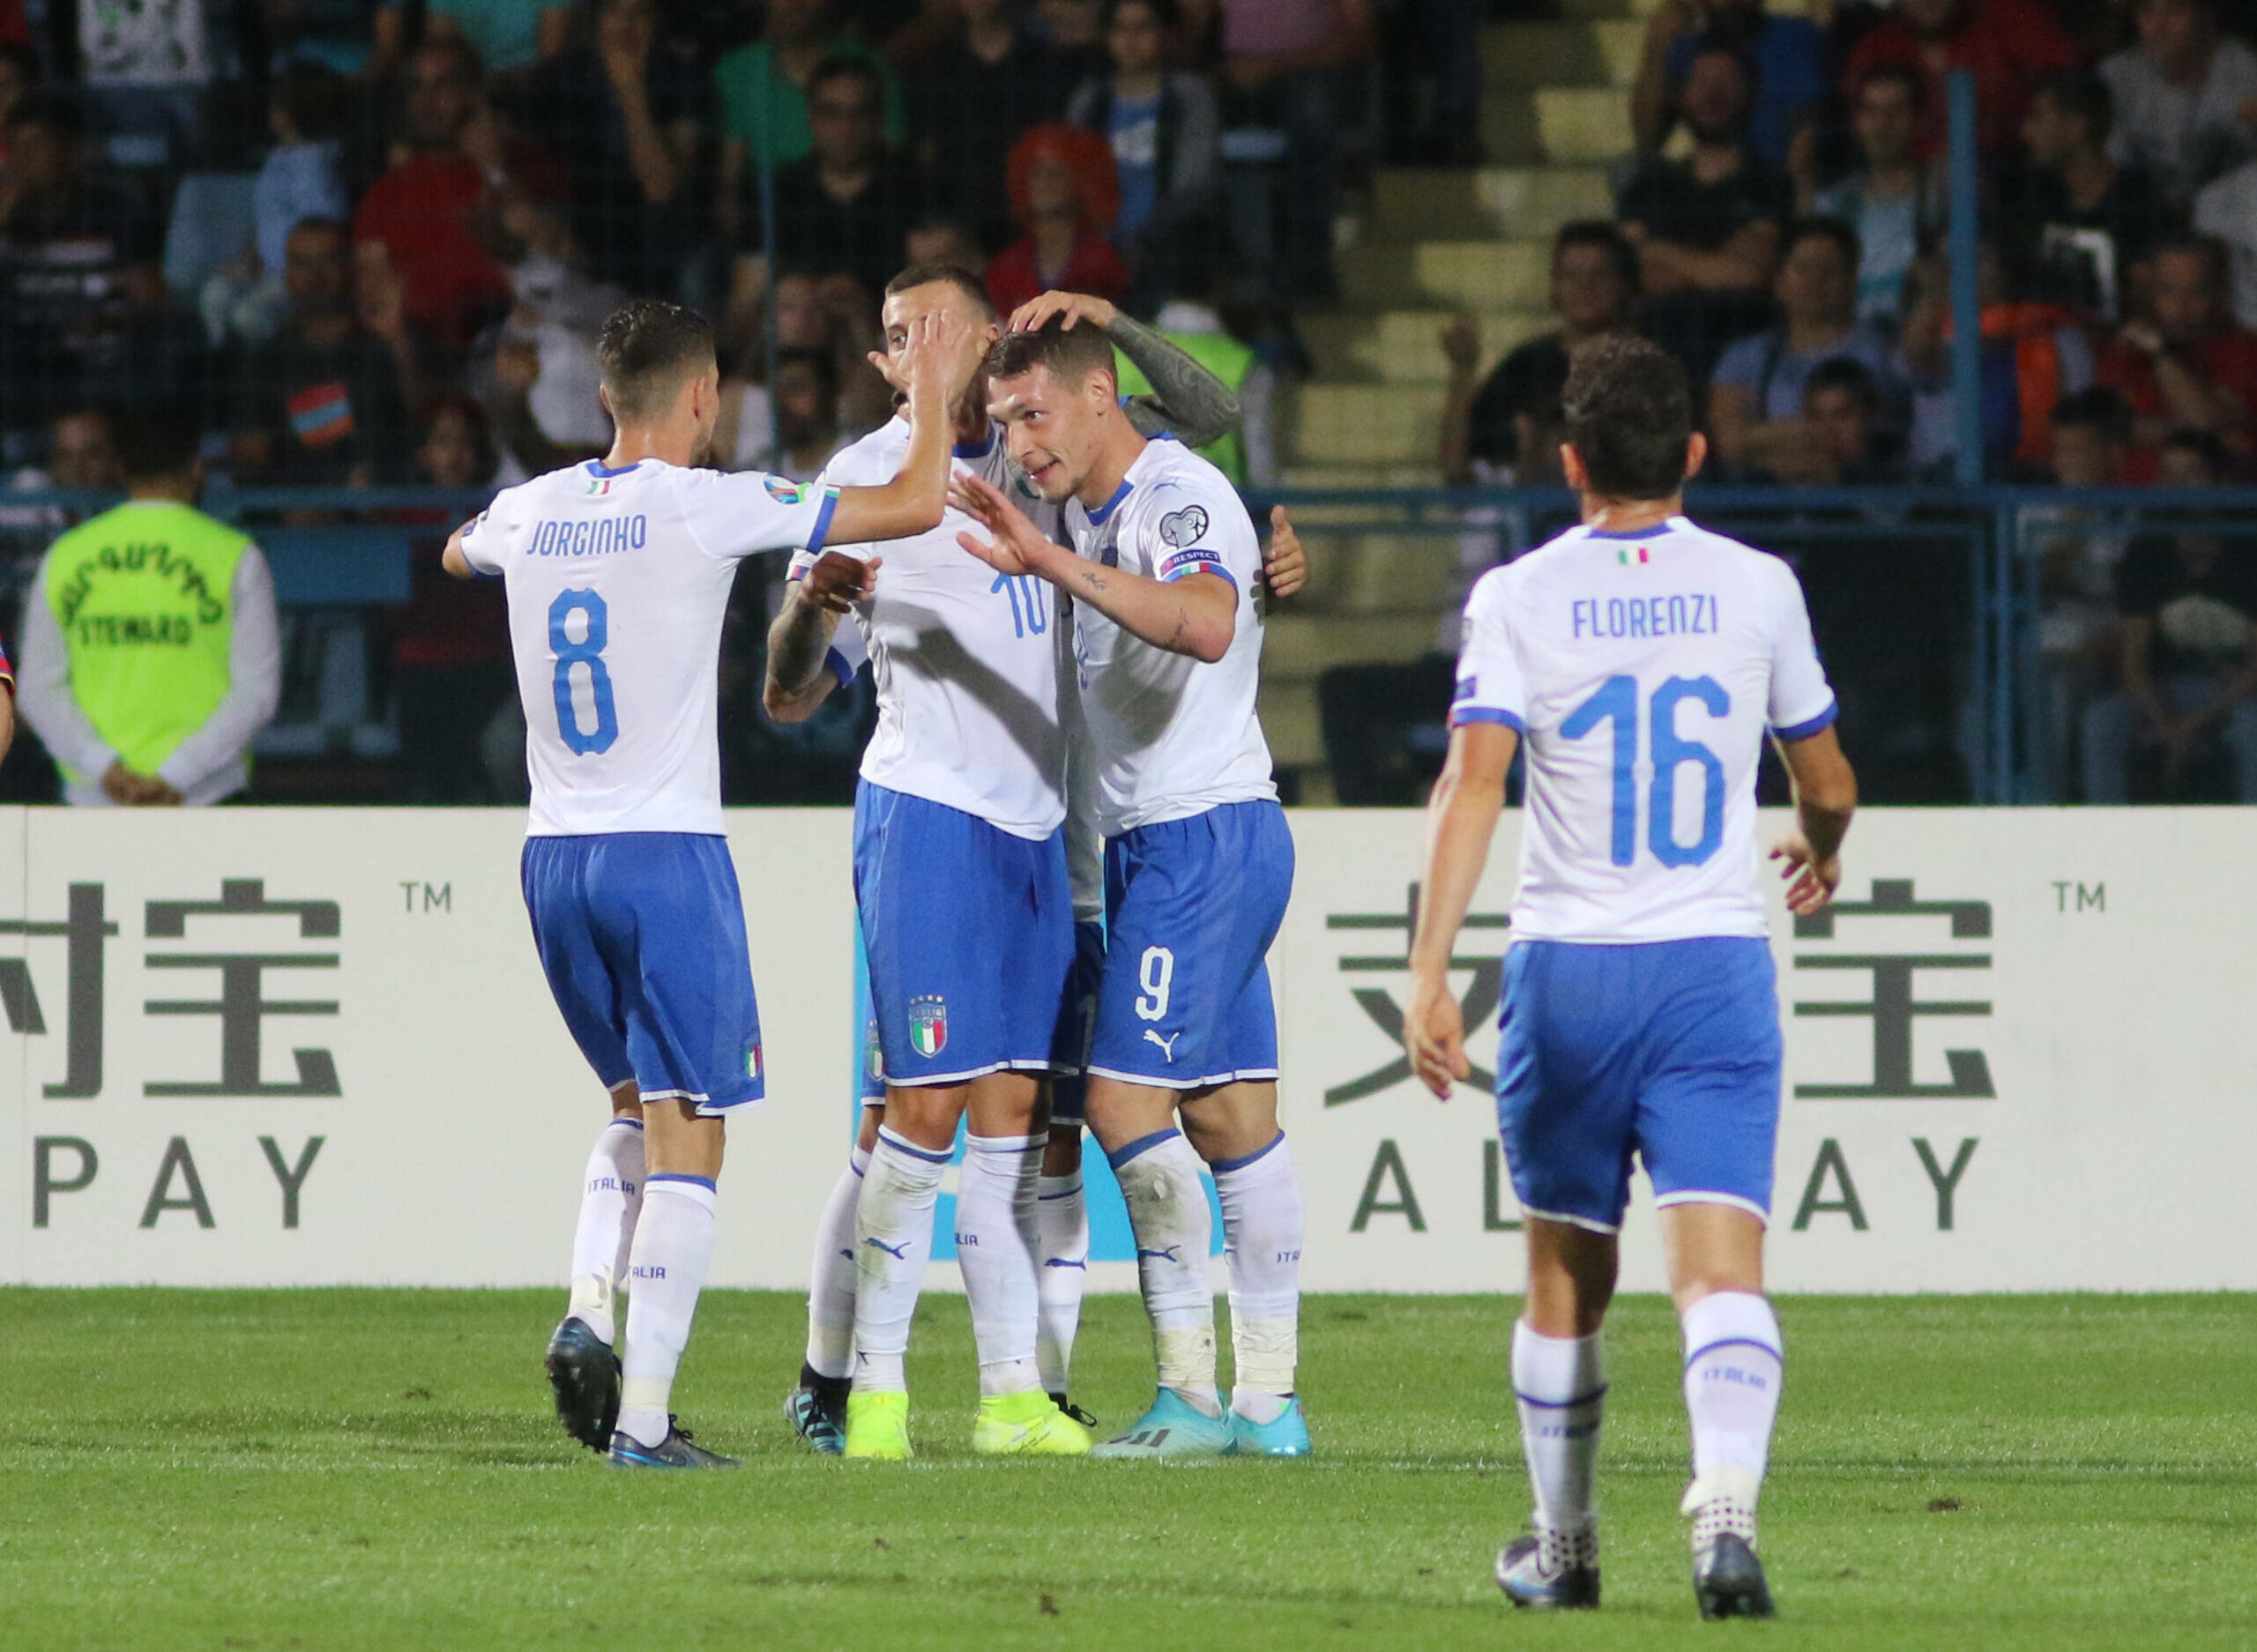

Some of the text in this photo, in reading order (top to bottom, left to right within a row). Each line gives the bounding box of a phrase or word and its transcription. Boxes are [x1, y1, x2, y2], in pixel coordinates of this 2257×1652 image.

[526, 514, 647, 556] JORGINHO
[1173, 551, 1219, 565] RESPECT
[1572, 593, 1719, 639] FLORENZI
[548, 587, 619, 756] 8
[1559, 674, 1730, 869] 16
[400, 882, 451, 912] TM
[2052, 882, 2105, 912] TM
[1135, 946, 1175, 1022] 9
[33, 1135, 326, 1229] PAY
[588, 1178, 635, 1195] ITALIA
[1349, 1138, 1980, 1232] ALAY
